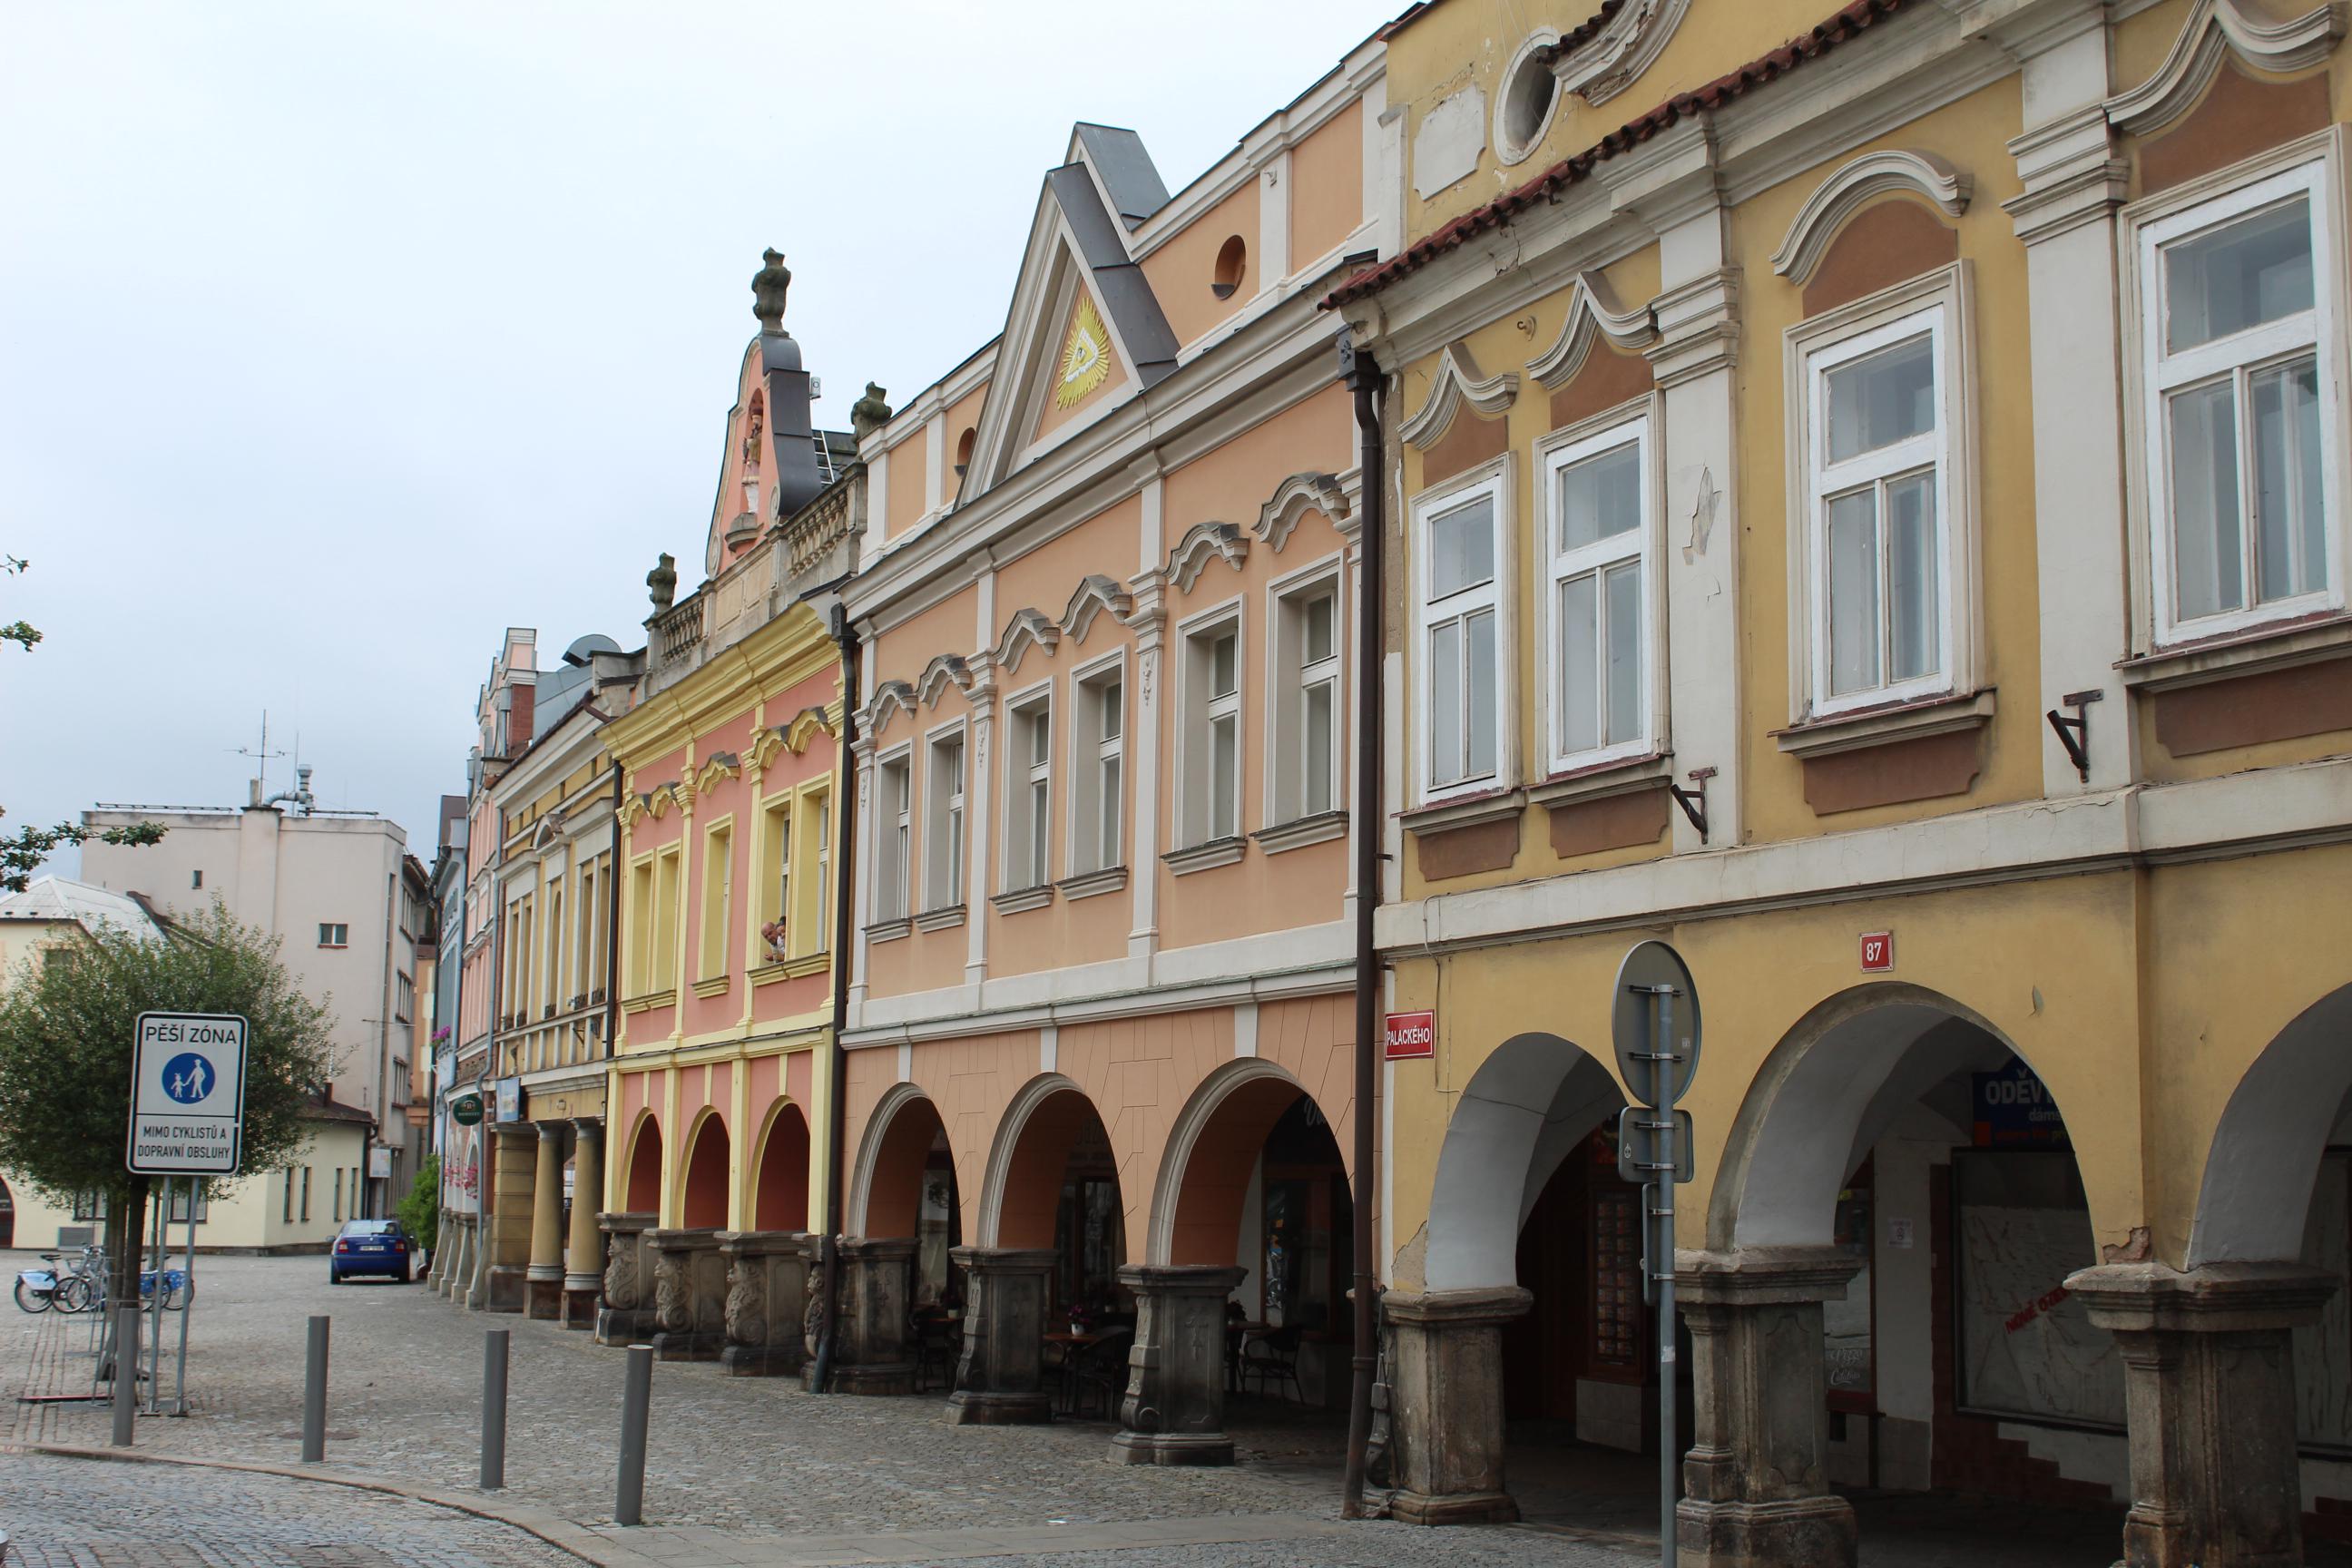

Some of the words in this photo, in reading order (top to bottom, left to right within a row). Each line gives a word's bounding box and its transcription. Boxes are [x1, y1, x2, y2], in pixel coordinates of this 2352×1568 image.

[1867, 942, 1882, 962] 87
[145, 1024, 184, 1042] PĚŠÍ
[190, 1024, 237, 1044] ZÓNA
[1387, 1024, 1430, 1045] PALACKÉHO
[143, 1125, 170, 1138] MIMO
[173, 1124, 217, 1139] CYKLISTŮ
[220, 1127, 227, 1140] A
[138, 1143, 184, 1157] DOPRAVNÍ
[187, 1146, 230, 1159] OBSLUHY
